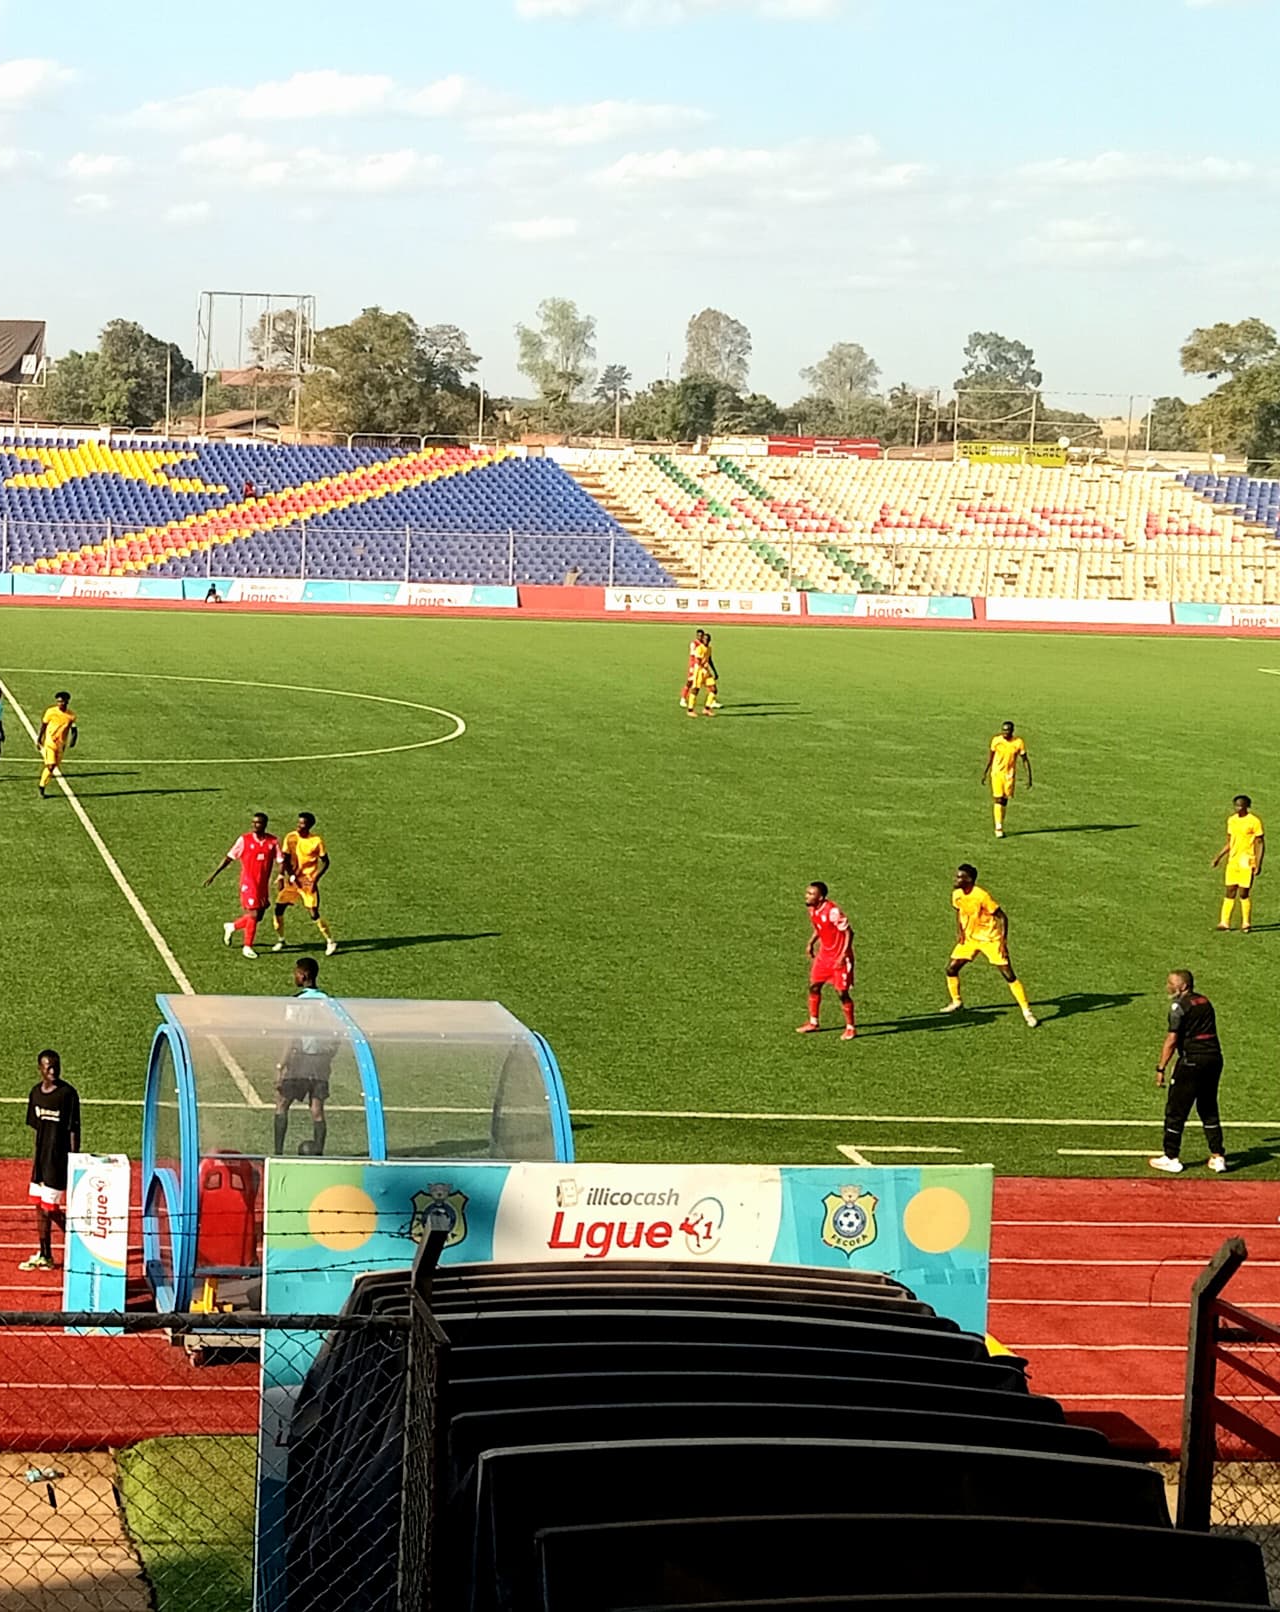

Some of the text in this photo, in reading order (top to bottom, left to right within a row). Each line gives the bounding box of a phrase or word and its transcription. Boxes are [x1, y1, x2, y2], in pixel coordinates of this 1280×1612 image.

[586, 1187, 680, 1206] illicocash
[93, 1195, 112, 1239] Ligue
[547, 1211, 713, 1258] Ligue 1
[831, 1234, 868, 1247] FECOFA
